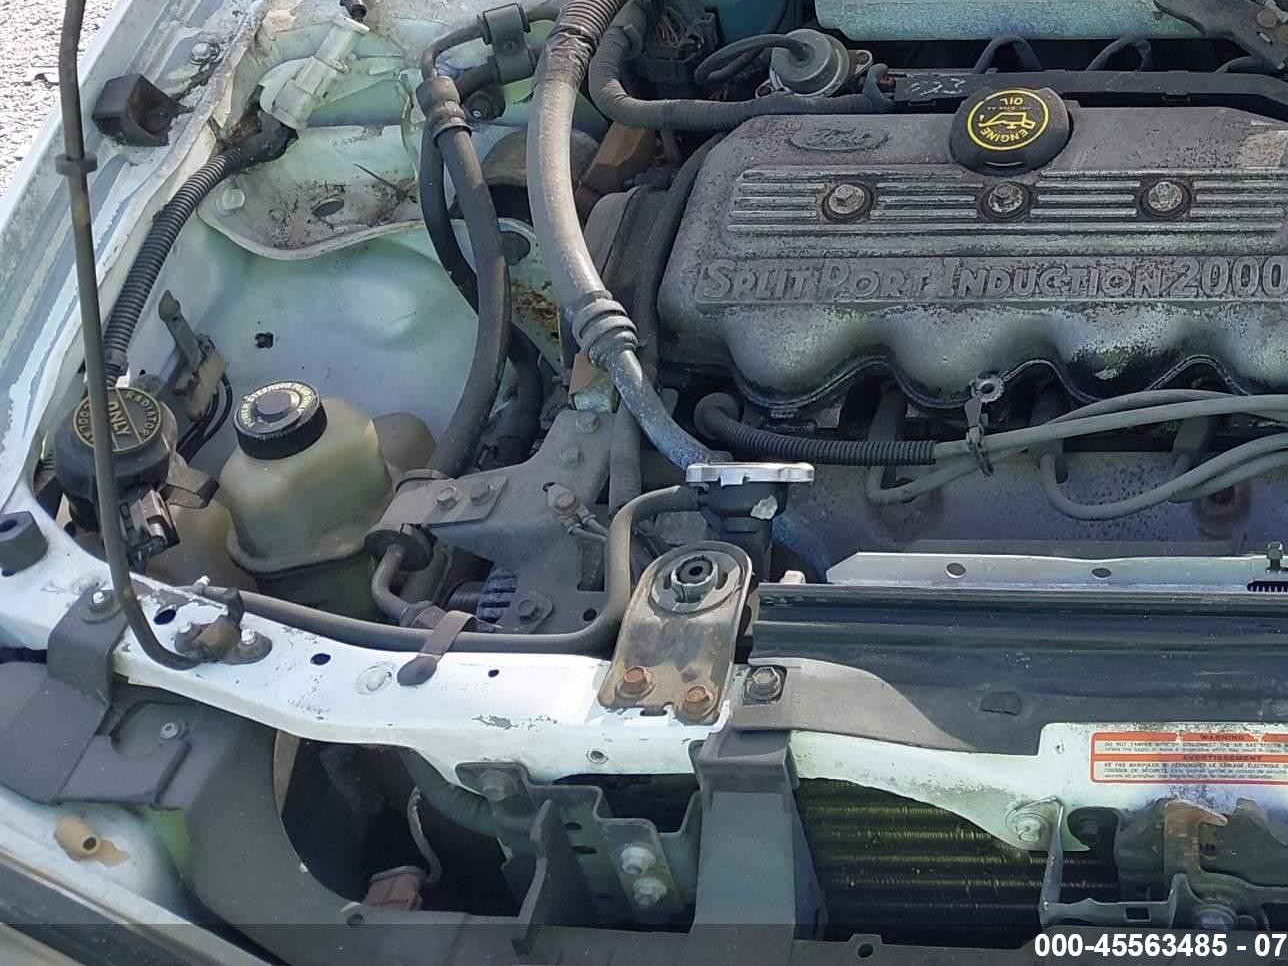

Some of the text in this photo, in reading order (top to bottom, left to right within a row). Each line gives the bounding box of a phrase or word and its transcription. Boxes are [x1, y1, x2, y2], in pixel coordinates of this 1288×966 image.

[1000, 97, 1024, 106] OIL
[980, 127, 1029, 143] ENGINE
[703, 258, 812, 299] SPLIT
[815, 258, 931, 298] PORT
[942, 256, 1163, 297] INDUCTION
[108, 401, 131, 436] ONLY
[1199, 733, 1245, 742] WARNING
